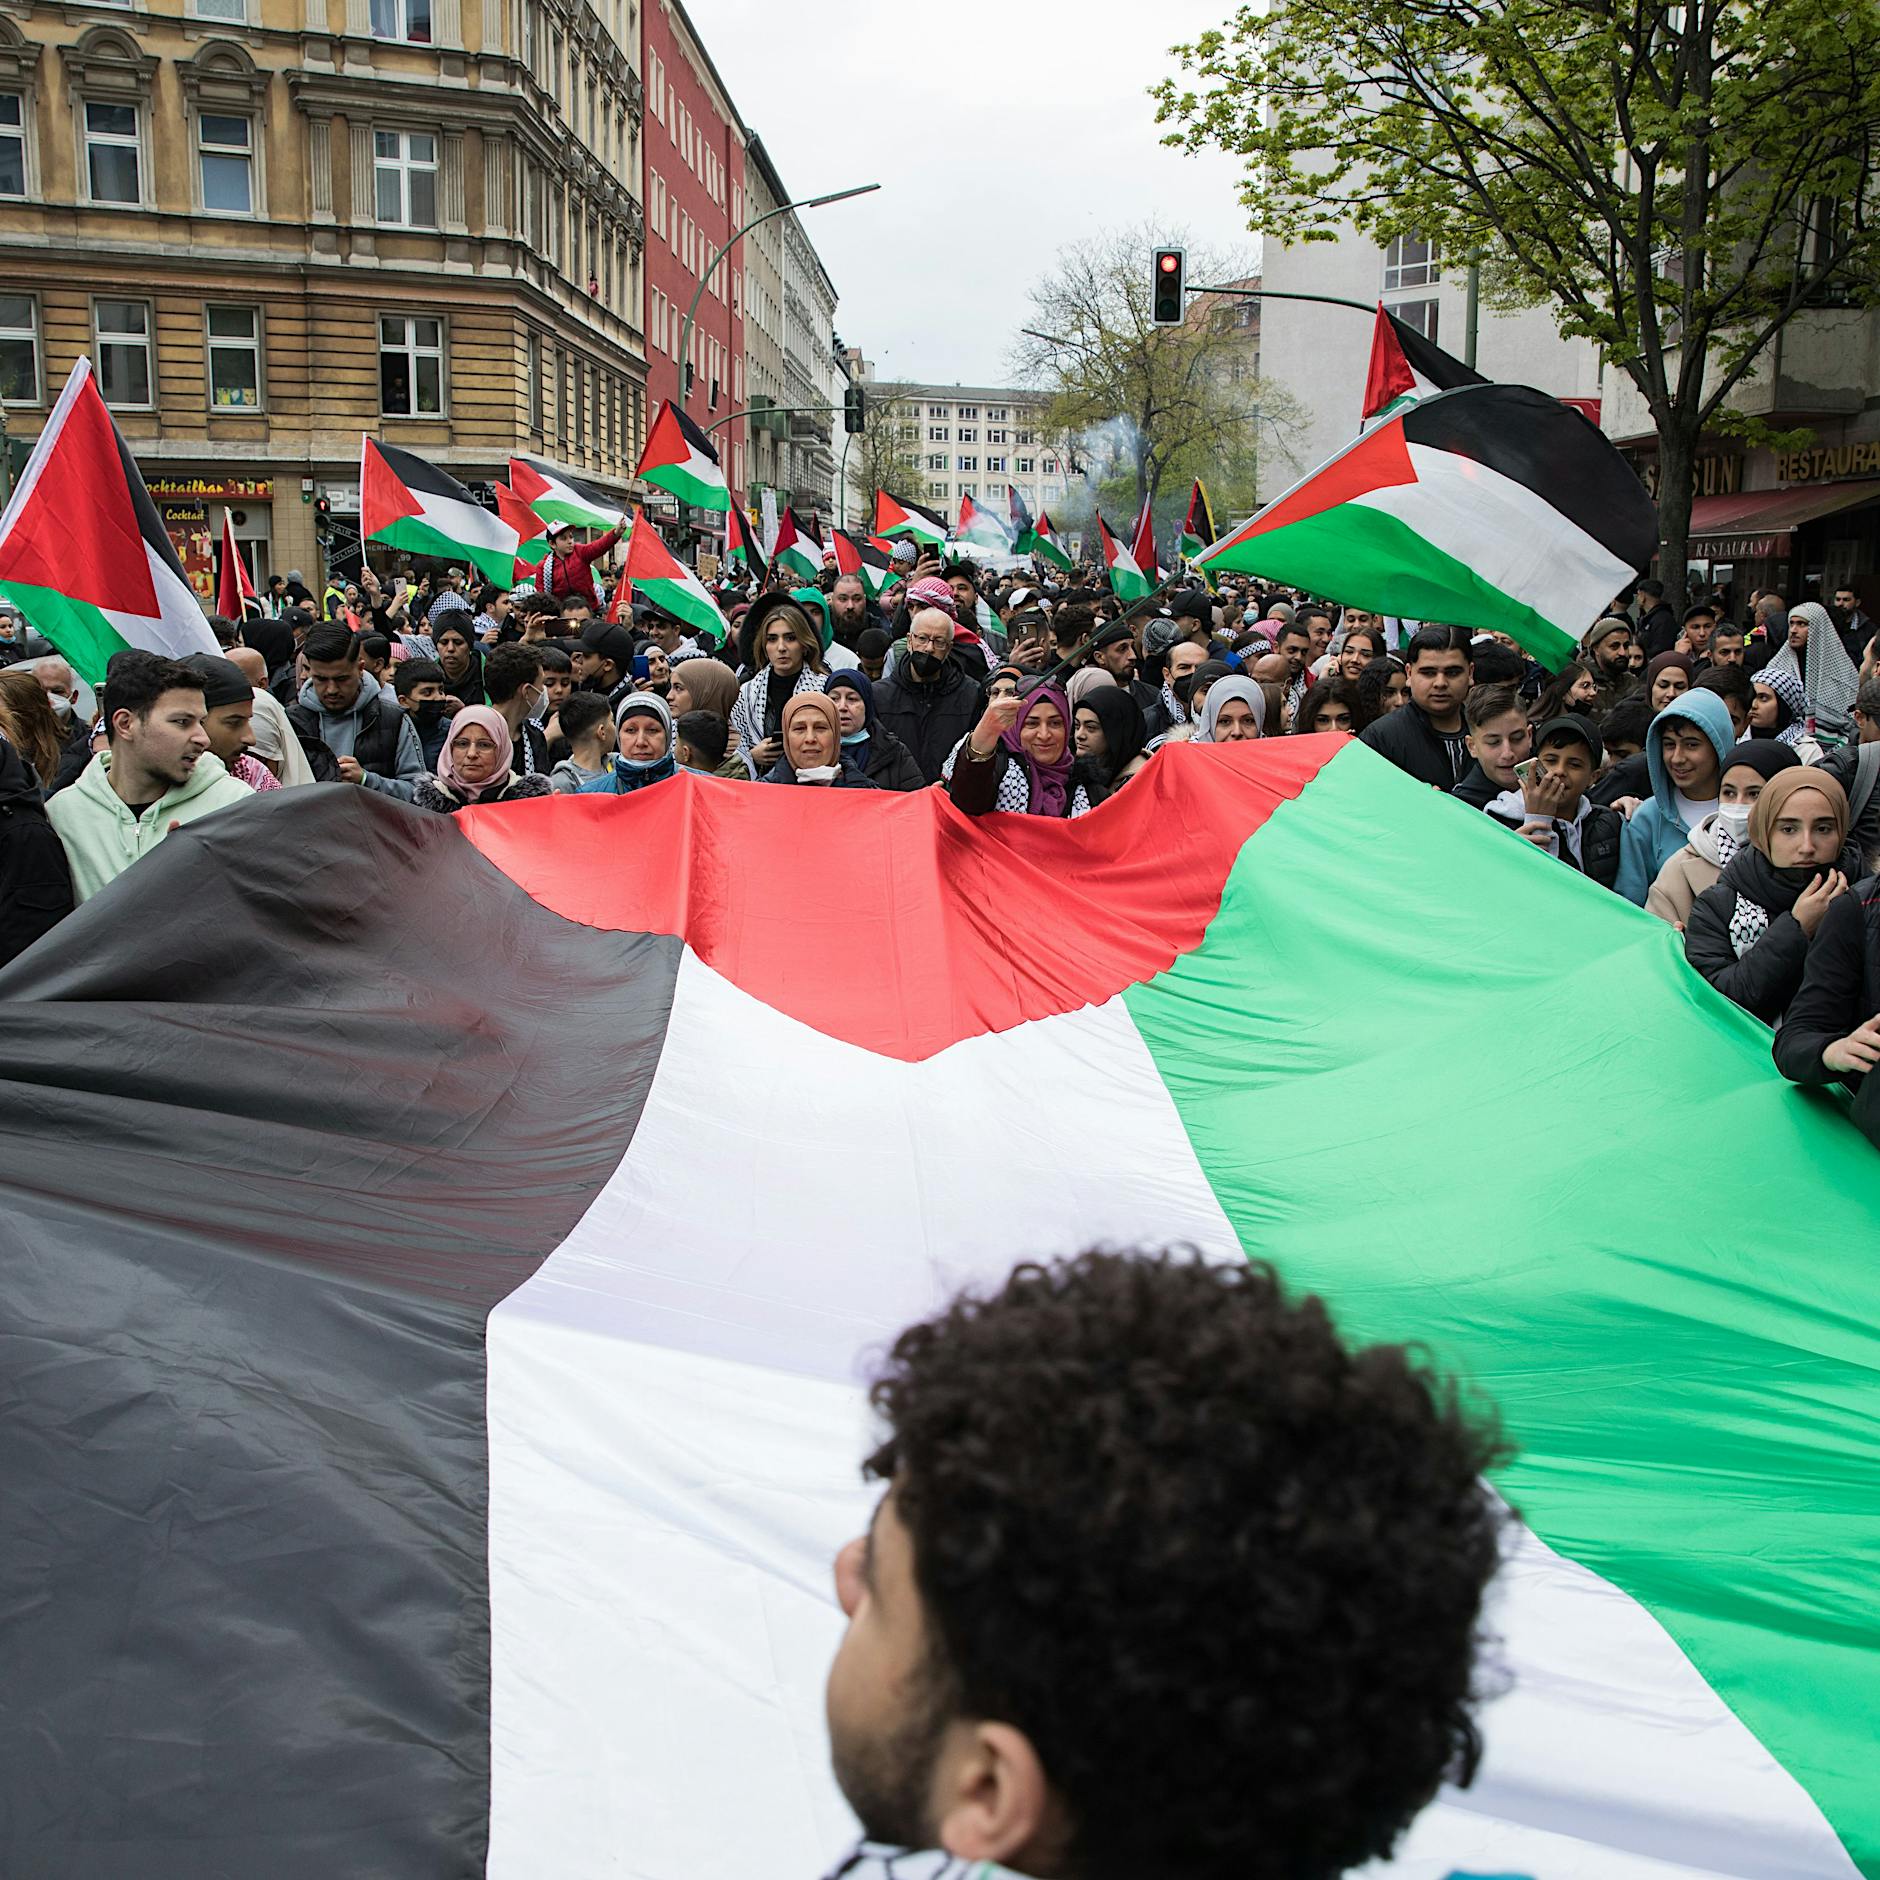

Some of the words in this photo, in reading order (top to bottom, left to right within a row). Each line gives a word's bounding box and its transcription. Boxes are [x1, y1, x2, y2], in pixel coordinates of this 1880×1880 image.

[1776, 442, 1880, 481] RESTAURA
[146, 479, 224, 493] ocktailbar
[1646, 454, 1734, 500] SSUN
[331, 544, 360, 563] TYLING
[1695, 540, 1773, 558] RESTAURANT
